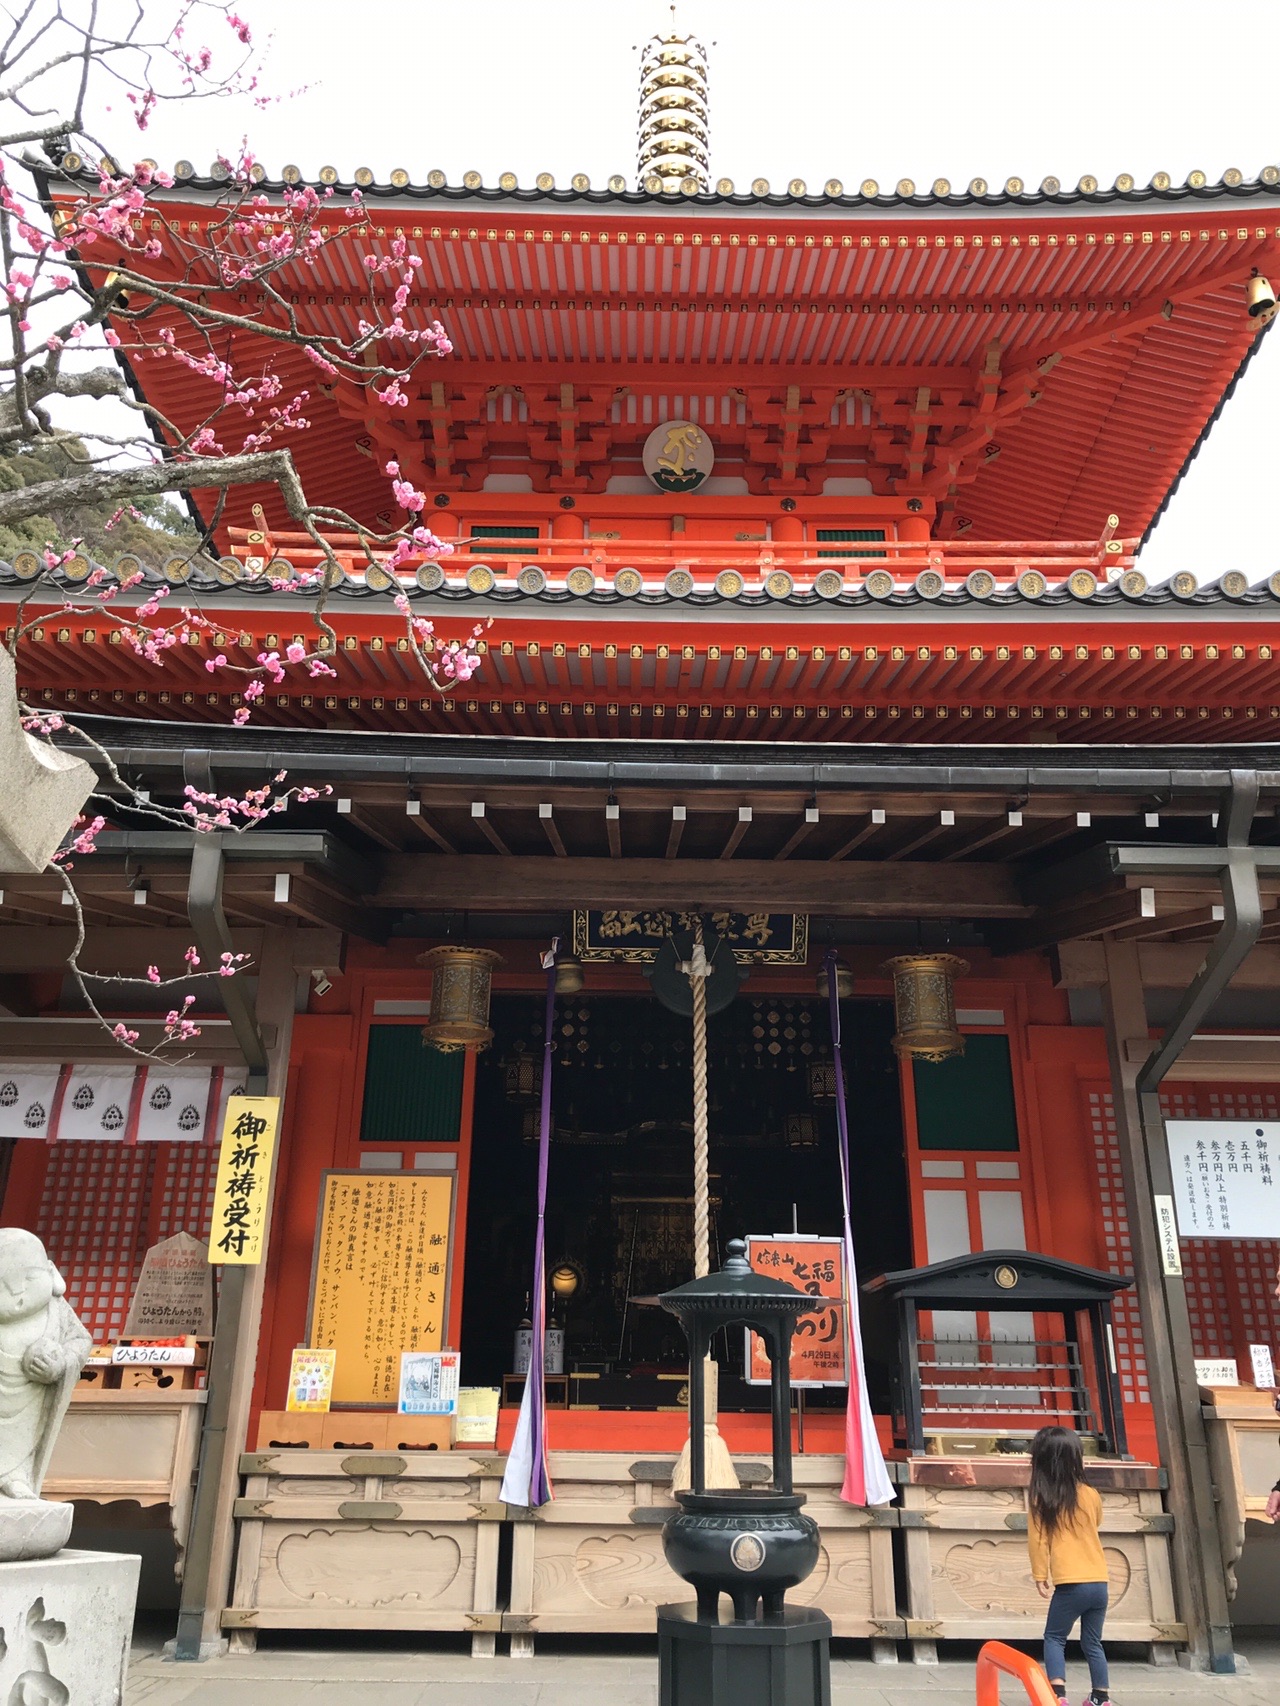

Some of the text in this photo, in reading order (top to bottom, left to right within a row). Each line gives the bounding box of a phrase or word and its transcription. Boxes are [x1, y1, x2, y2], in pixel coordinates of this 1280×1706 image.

[1225, 1140, 1238, 1173] 壱万円
[1240, 1140, 1253, 1173] 五千円
[1256, 1139, 1273, 1186] 御祈祷料
[217, 1111, 267, 1257] 御祈祷受付
[344, 1187, 361, 1270] 融通さんの御真言は
[1160, 1207, 1177, 1269] 防犯システム設置
[756, 1248, 794, 1267] 信貴山
[423, 1233, 442, 1334] 融通さん
[116, 1349, 172, 1362] ひょうたん
[801, 1350, 831, 1360] 4月29日
[813, 1361, 840, 1369] 午後2時
